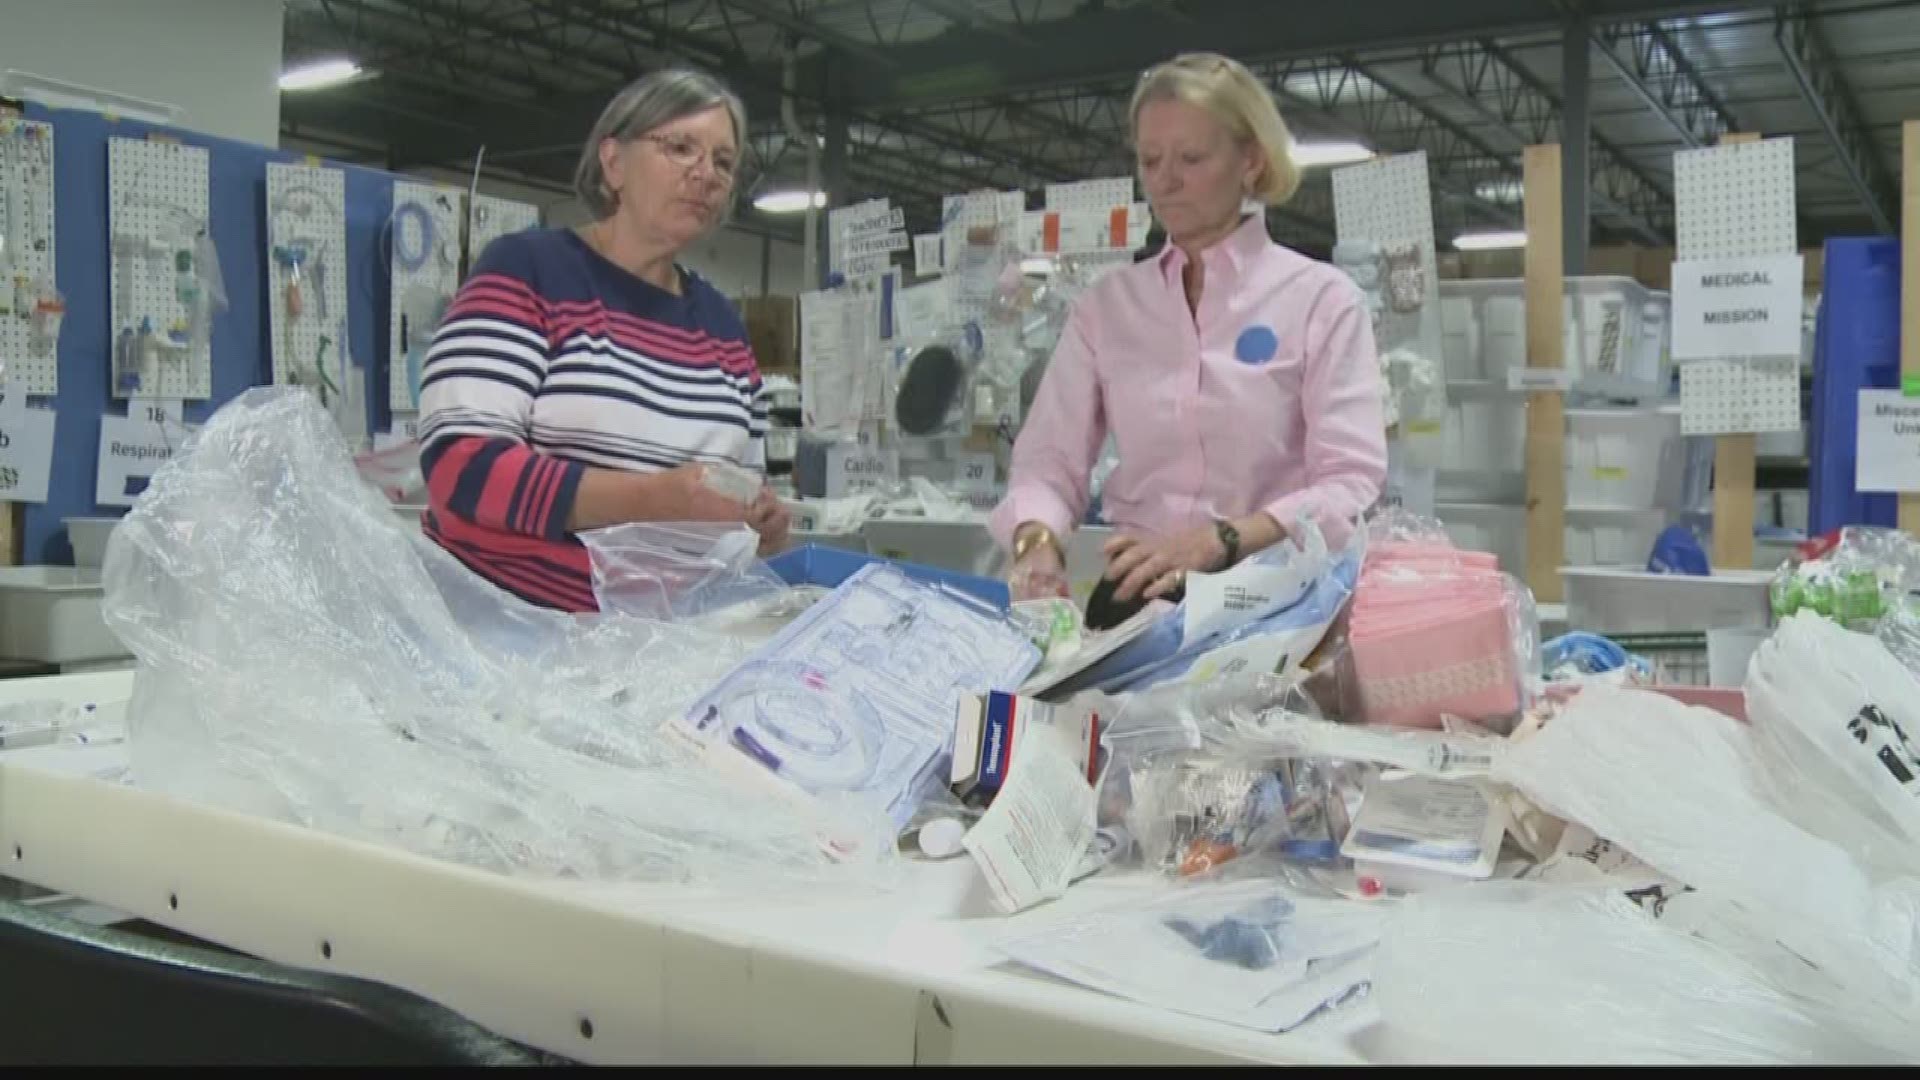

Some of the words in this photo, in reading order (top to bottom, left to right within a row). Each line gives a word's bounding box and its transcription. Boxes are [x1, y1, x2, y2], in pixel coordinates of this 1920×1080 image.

[1701, 271, 1772, 287] MEDICAL
[1703, 309, 1768, 324] MISSION
[146, 407, 165, 423] 18
[844, 457, 885, 473] Cardio
[966, 464, 983, 479] 20
